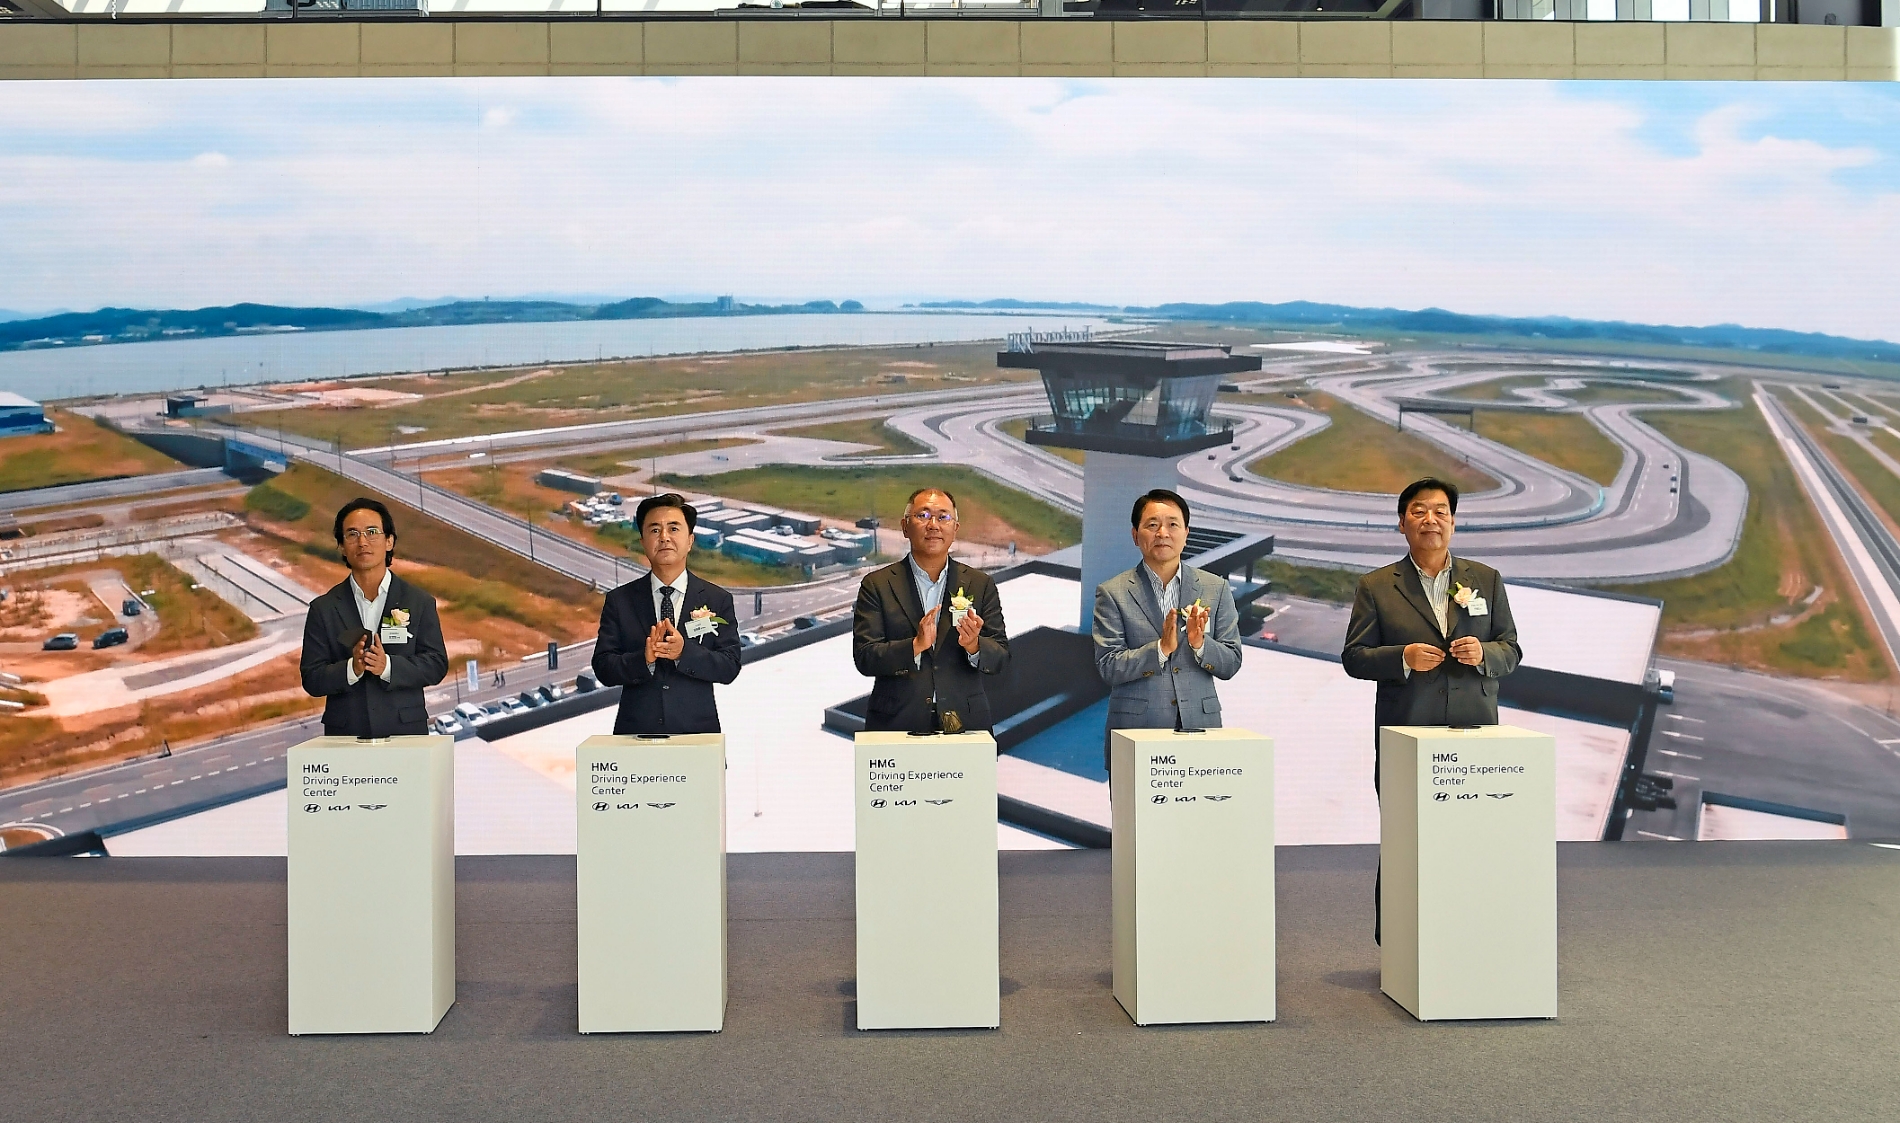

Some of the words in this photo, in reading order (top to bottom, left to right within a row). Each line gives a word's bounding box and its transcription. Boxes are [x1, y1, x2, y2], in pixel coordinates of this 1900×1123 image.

[1150, 755, 1177, 765] HMG
[1432, 752, 1458, 763] HMG
[302, 763, 330, 774] HMG
[591, 762, 619, 772] HMG
[869, 758, 896, 769] HMG
[1150, 767, 1186, 778] Driving
[1188, 766, 1243, 778] Experience
[1432, 765, 1468, 776] Driving
[1470, 764, 1525, 776] Experience
[302, 775, 340, 787] Driving
[341, 775, 399, 787] Experience
[591, 774, 628, 785] Driving
[630, 773, 687, 785] Experience
[869, 771, 906, 782] Driving
[908, 770, 964, 782] Experience
[1432, 776, 1466, 786] Center
[869, 782, 904, 793] Center
[1150, 779, 1184, 789] Center
[302, 787, 338, 797] Center
[591, 786, 626, 795] Center
